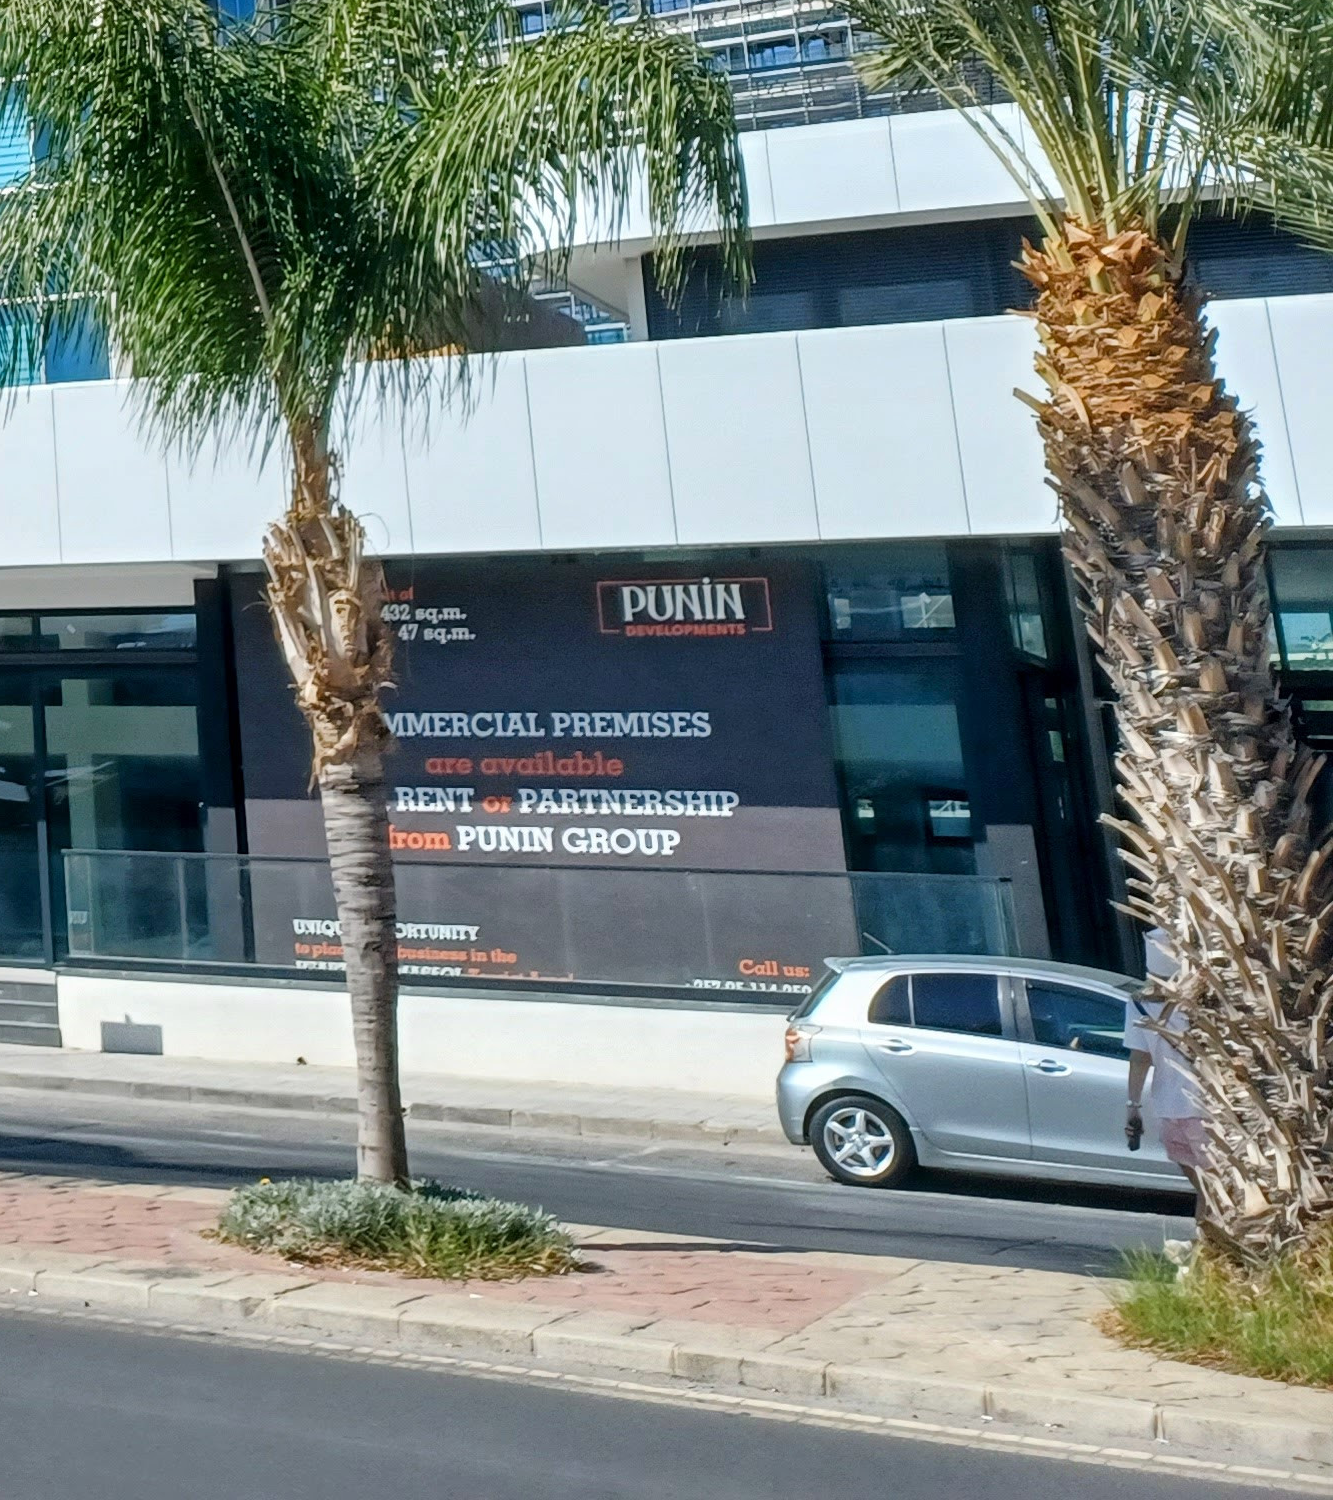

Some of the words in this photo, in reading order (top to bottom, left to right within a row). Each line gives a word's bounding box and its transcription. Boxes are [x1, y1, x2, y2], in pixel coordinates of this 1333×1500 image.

[625, 623, 746, 637] DEVELOPMENTS
[383, 712, 546, 738] MMERCIAL
[551, 711, 712, 738] PREMISES
[425, 757, 474, 775] are
[480, 751, 624, 777] available
[395, 786, 475, 813] RENT
[482, 795, 512, 814] or
[518, 788, 740, 817] PARTNERSHIP
[456, 825, 554, 853] PUNIN
[562, 827, 681, 856] GROUP
[739, 959, 779, 976] Call
[782, 965, 810, 978] us:
